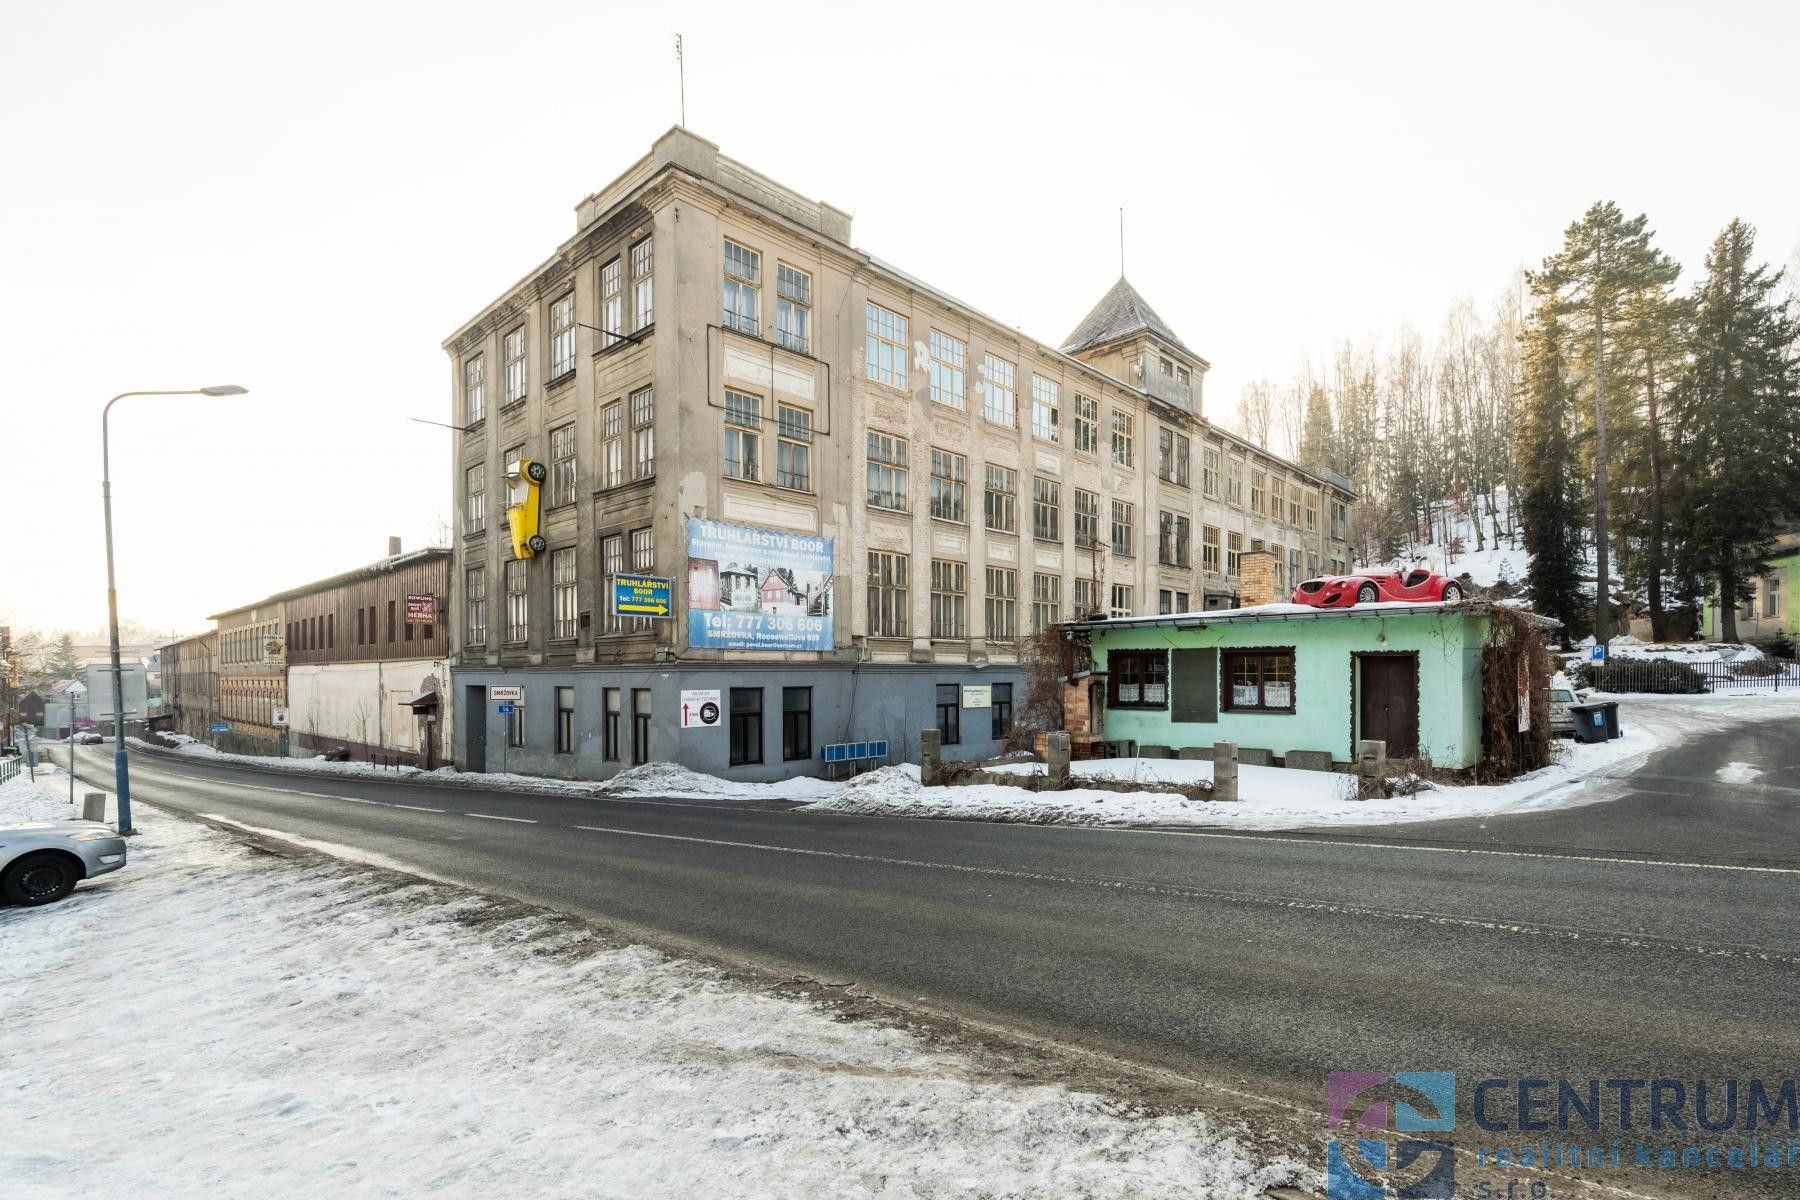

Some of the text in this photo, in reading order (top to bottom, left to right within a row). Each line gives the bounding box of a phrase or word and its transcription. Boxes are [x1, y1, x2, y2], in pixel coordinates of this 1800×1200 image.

[791, 538, 824, 552] BOOR
[704, 612, 731, 628] Tel:
[736, 614, 763, 630] 777
[797, 618, 823, 632] 606
[1594, 647, 1602, 655] P
